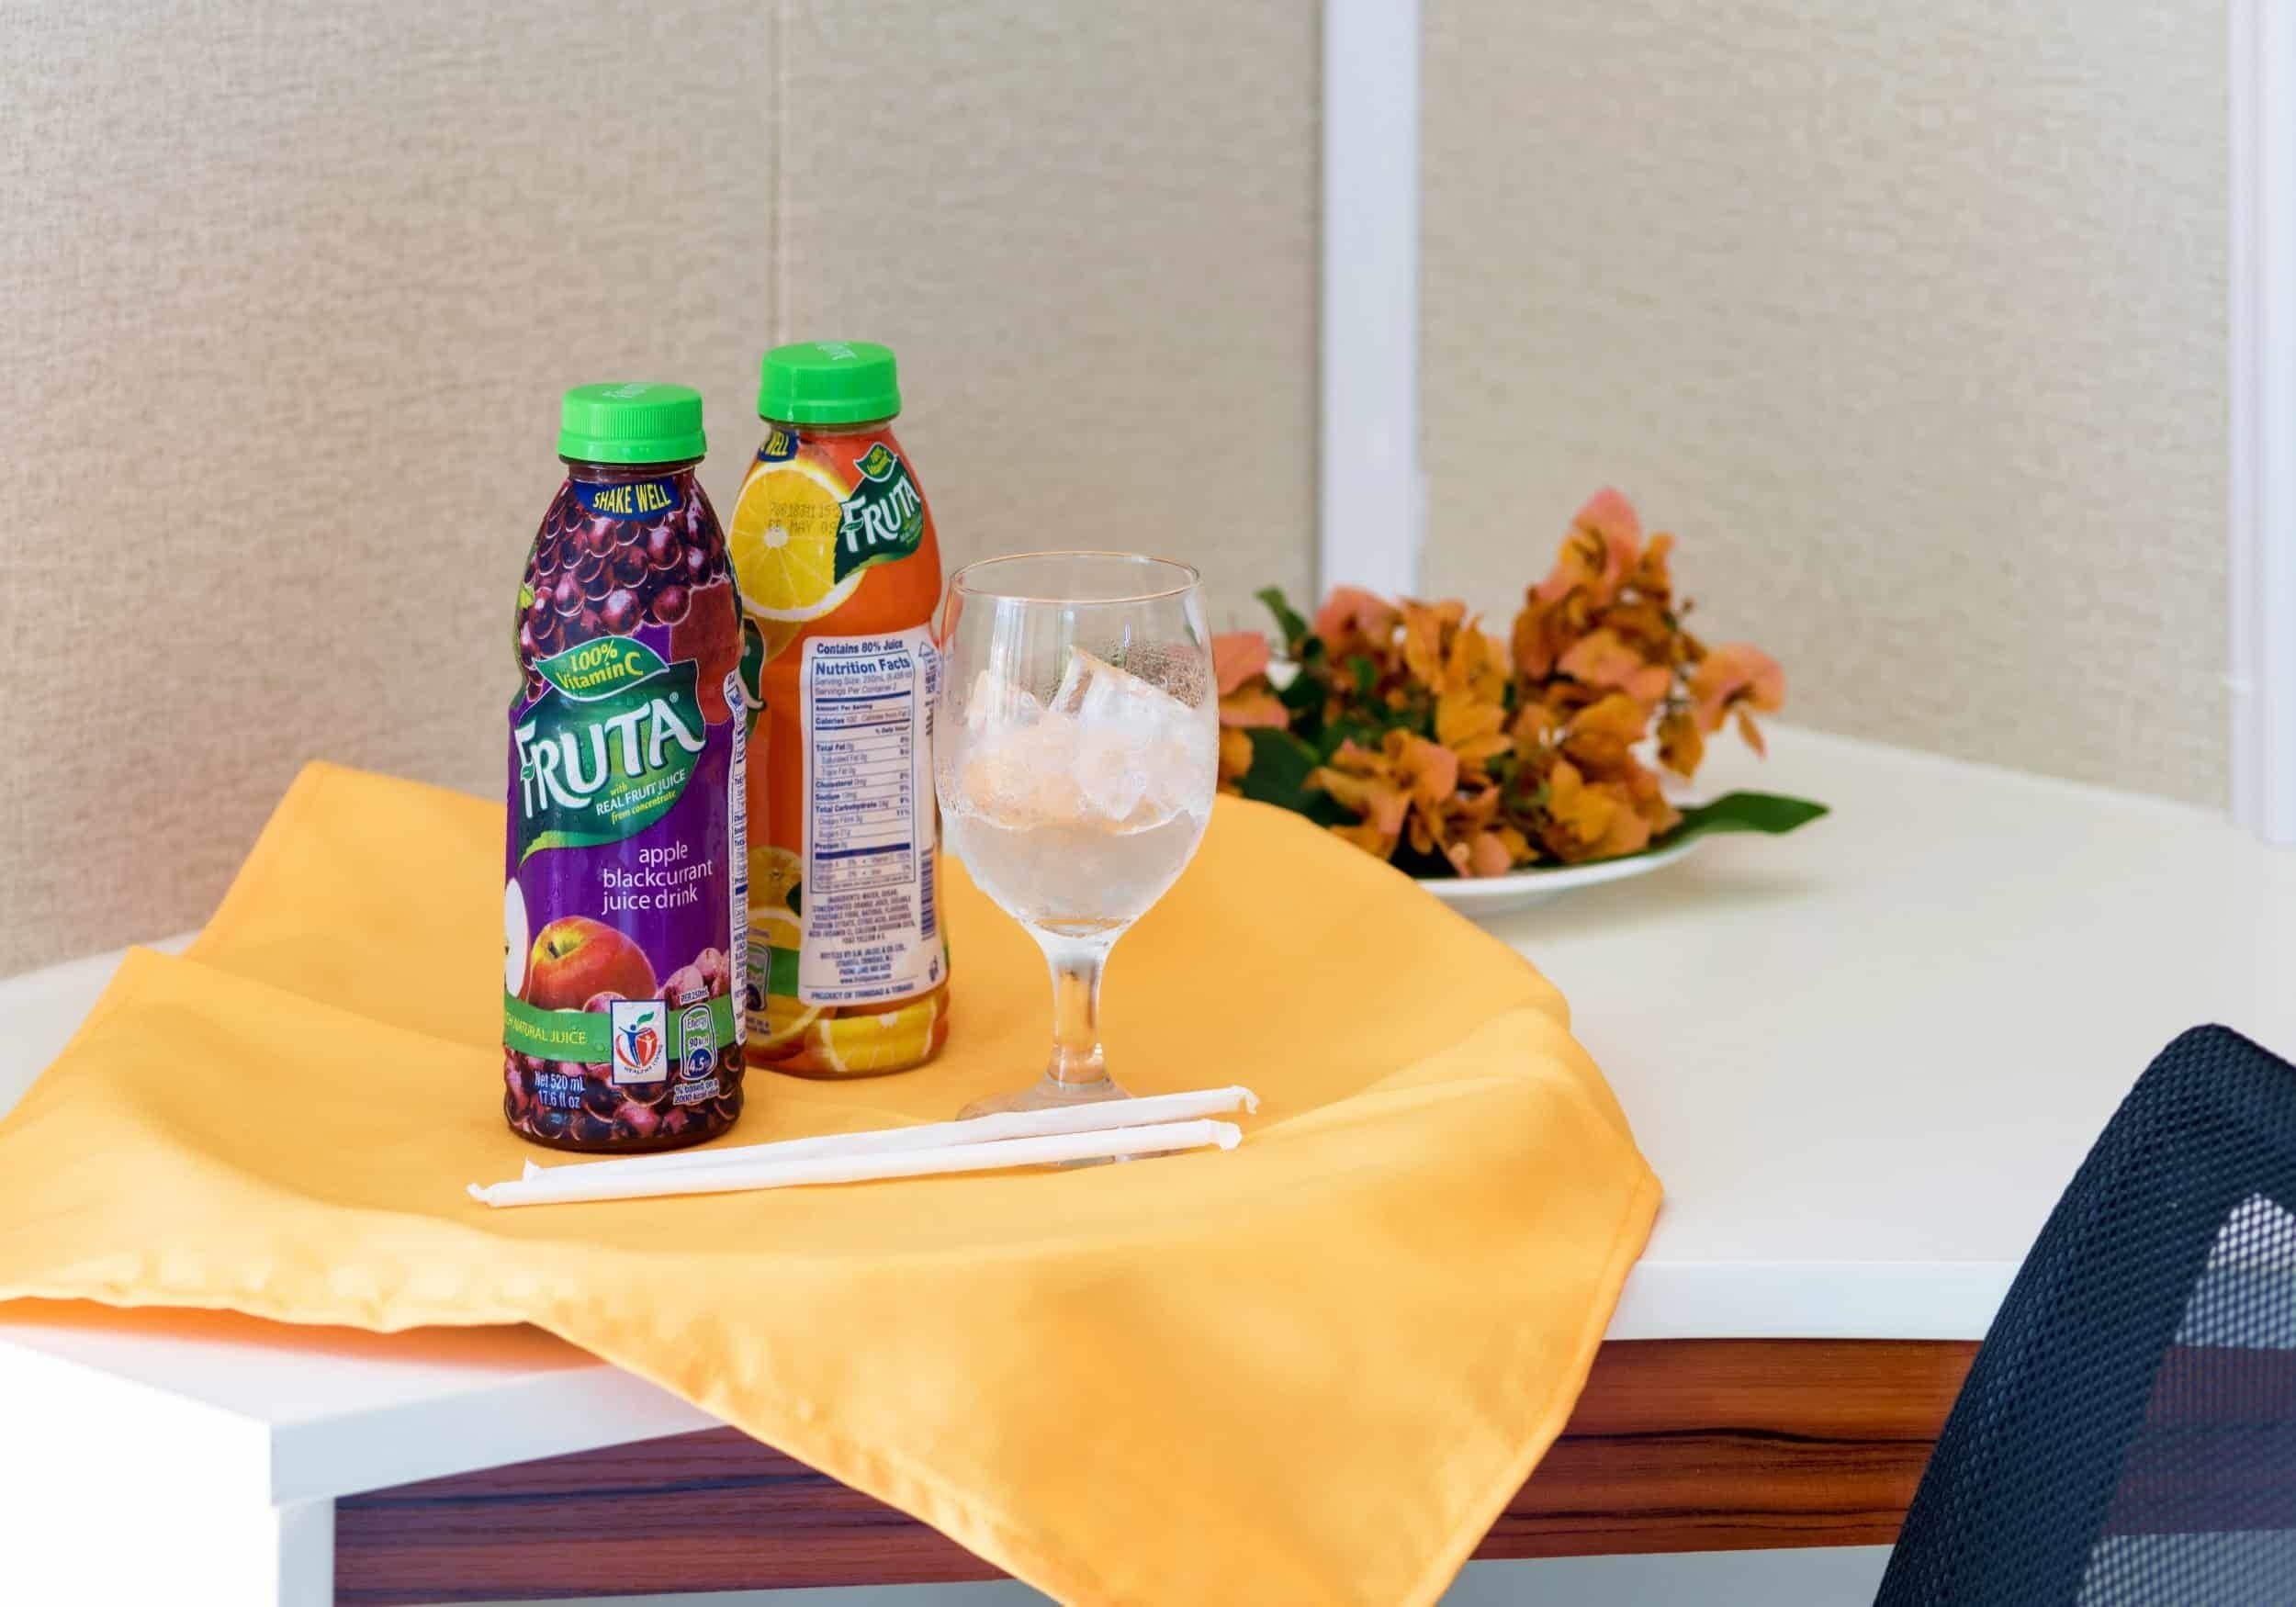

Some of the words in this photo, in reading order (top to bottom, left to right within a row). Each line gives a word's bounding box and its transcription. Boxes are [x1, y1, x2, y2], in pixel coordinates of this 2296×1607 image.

[592, 485, 633, 513] SHAKE
[636, 483, 671, 513] WELL
[839, 475, 920, 553] FRUTA
[569, 639, 618, 672] 100%
[816, 643, 859, 654] Contains
[861, 642, 881, 652] 80%
[884, 639, 903, 650] Juice
[556, 662, 625, 690] Vitamin
[625, 651, 644, 676] C
[816, 661, 876, 675] Nutrition
[878, 657, 911, 671] Facts
[514, 699, 706, 819] FRUTA
[816, 743, 833, 751] Total
[835, 742, 845, 750] Fat
[596, 797, 625, 816] REAL
[625, 782, 657, 802] FRUIT
[658, 768, 686, 794] JUICE
[610, 782, 628, 796] with
[612, 809, 631, 825] from
[632, 791, 677, 815] concentrate
[816, 805, 833, 814] Total
[639, 840, 688, 868] apple
[603, 859, 714, 888] blackcurrant
[602, 891, 651, 916] juice
[655, 883, 698, 909] drink
[550, 1028, 586, 1044] JUICE
[535, 1070, 549, 1087] Net
[550, 1073, 568, 1090] 520
[570, 1075, 586, 1092] mL
[538, 1090, 557, 1107] 17.6
[558, 1091, 567, 1108] fl
[568, 1096, 581, 1109] oz
